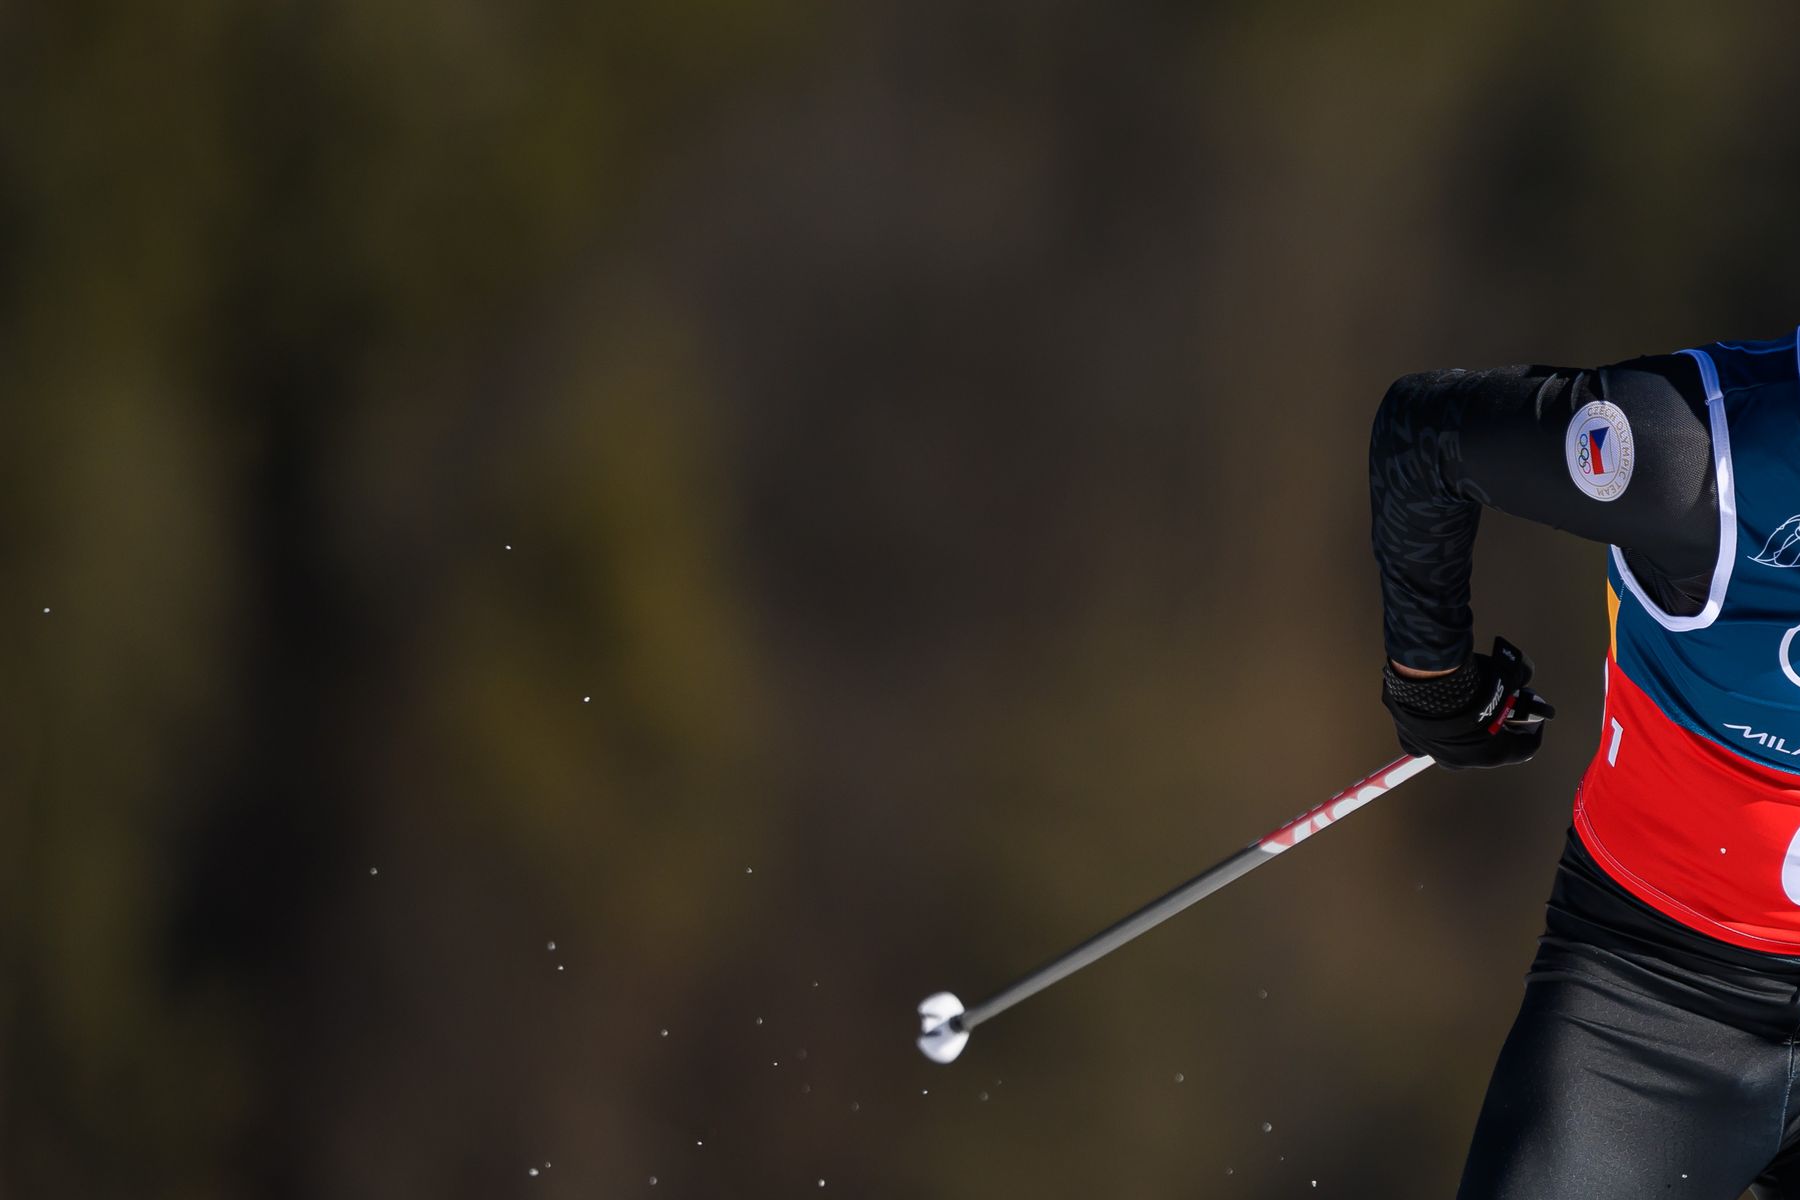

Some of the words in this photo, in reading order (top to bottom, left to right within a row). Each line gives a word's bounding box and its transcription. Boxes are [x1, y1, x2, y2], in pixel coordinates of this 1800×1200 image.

[1587, 406, 1617, 420] CZECH
[1616, 421, 1630, 480] OLYMPIC
[1596, 480, 1621, 497] TEAM
